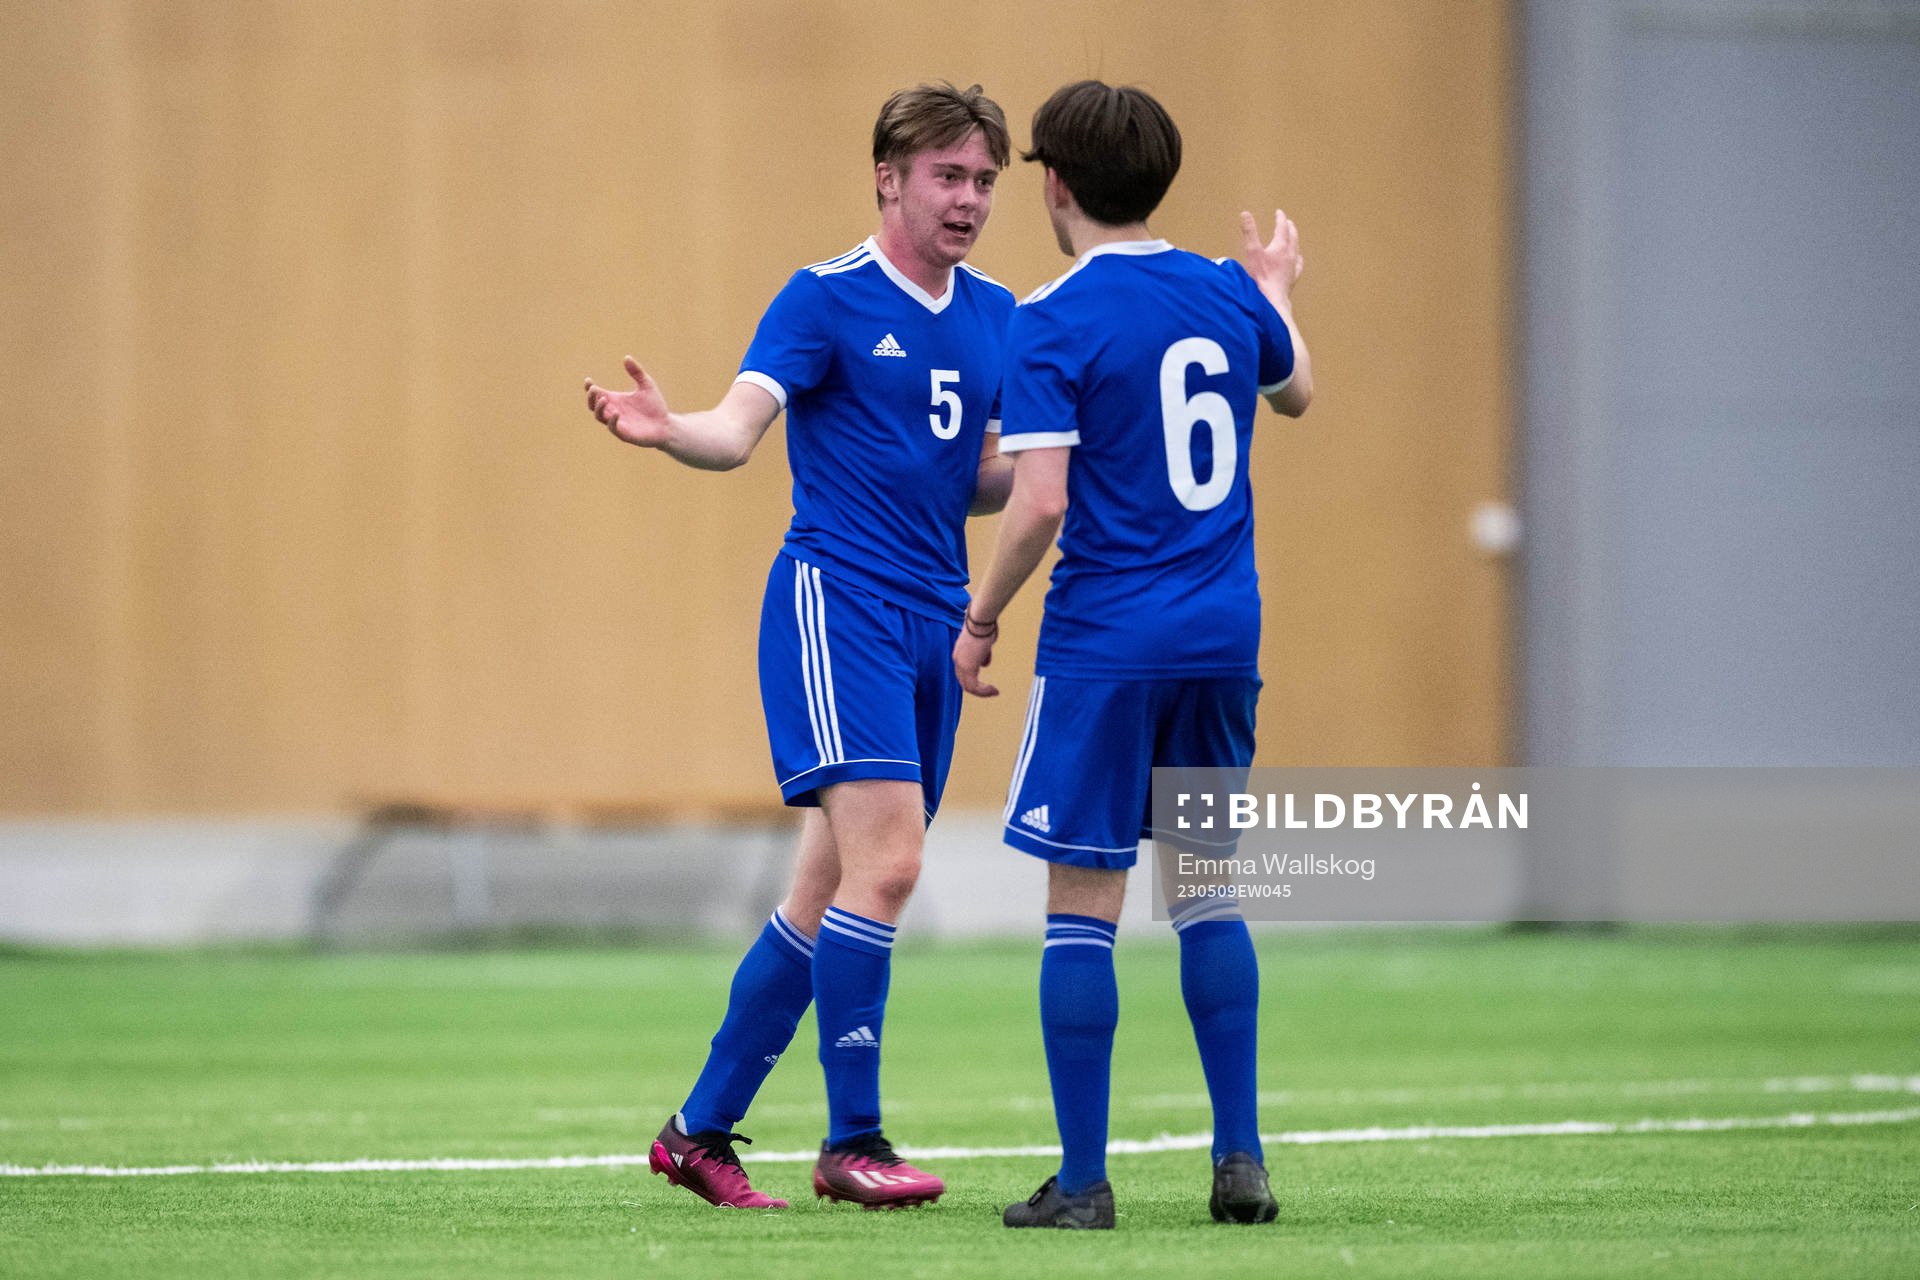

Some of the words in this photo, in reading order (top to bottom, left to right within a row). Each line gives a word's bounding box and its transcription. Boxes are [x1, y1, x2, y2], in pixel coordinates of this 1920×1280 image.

[872, 348, 907, 358] adidas
[928, 368, 963, 440] 5
[1159, 336, 1238, 512] 6
